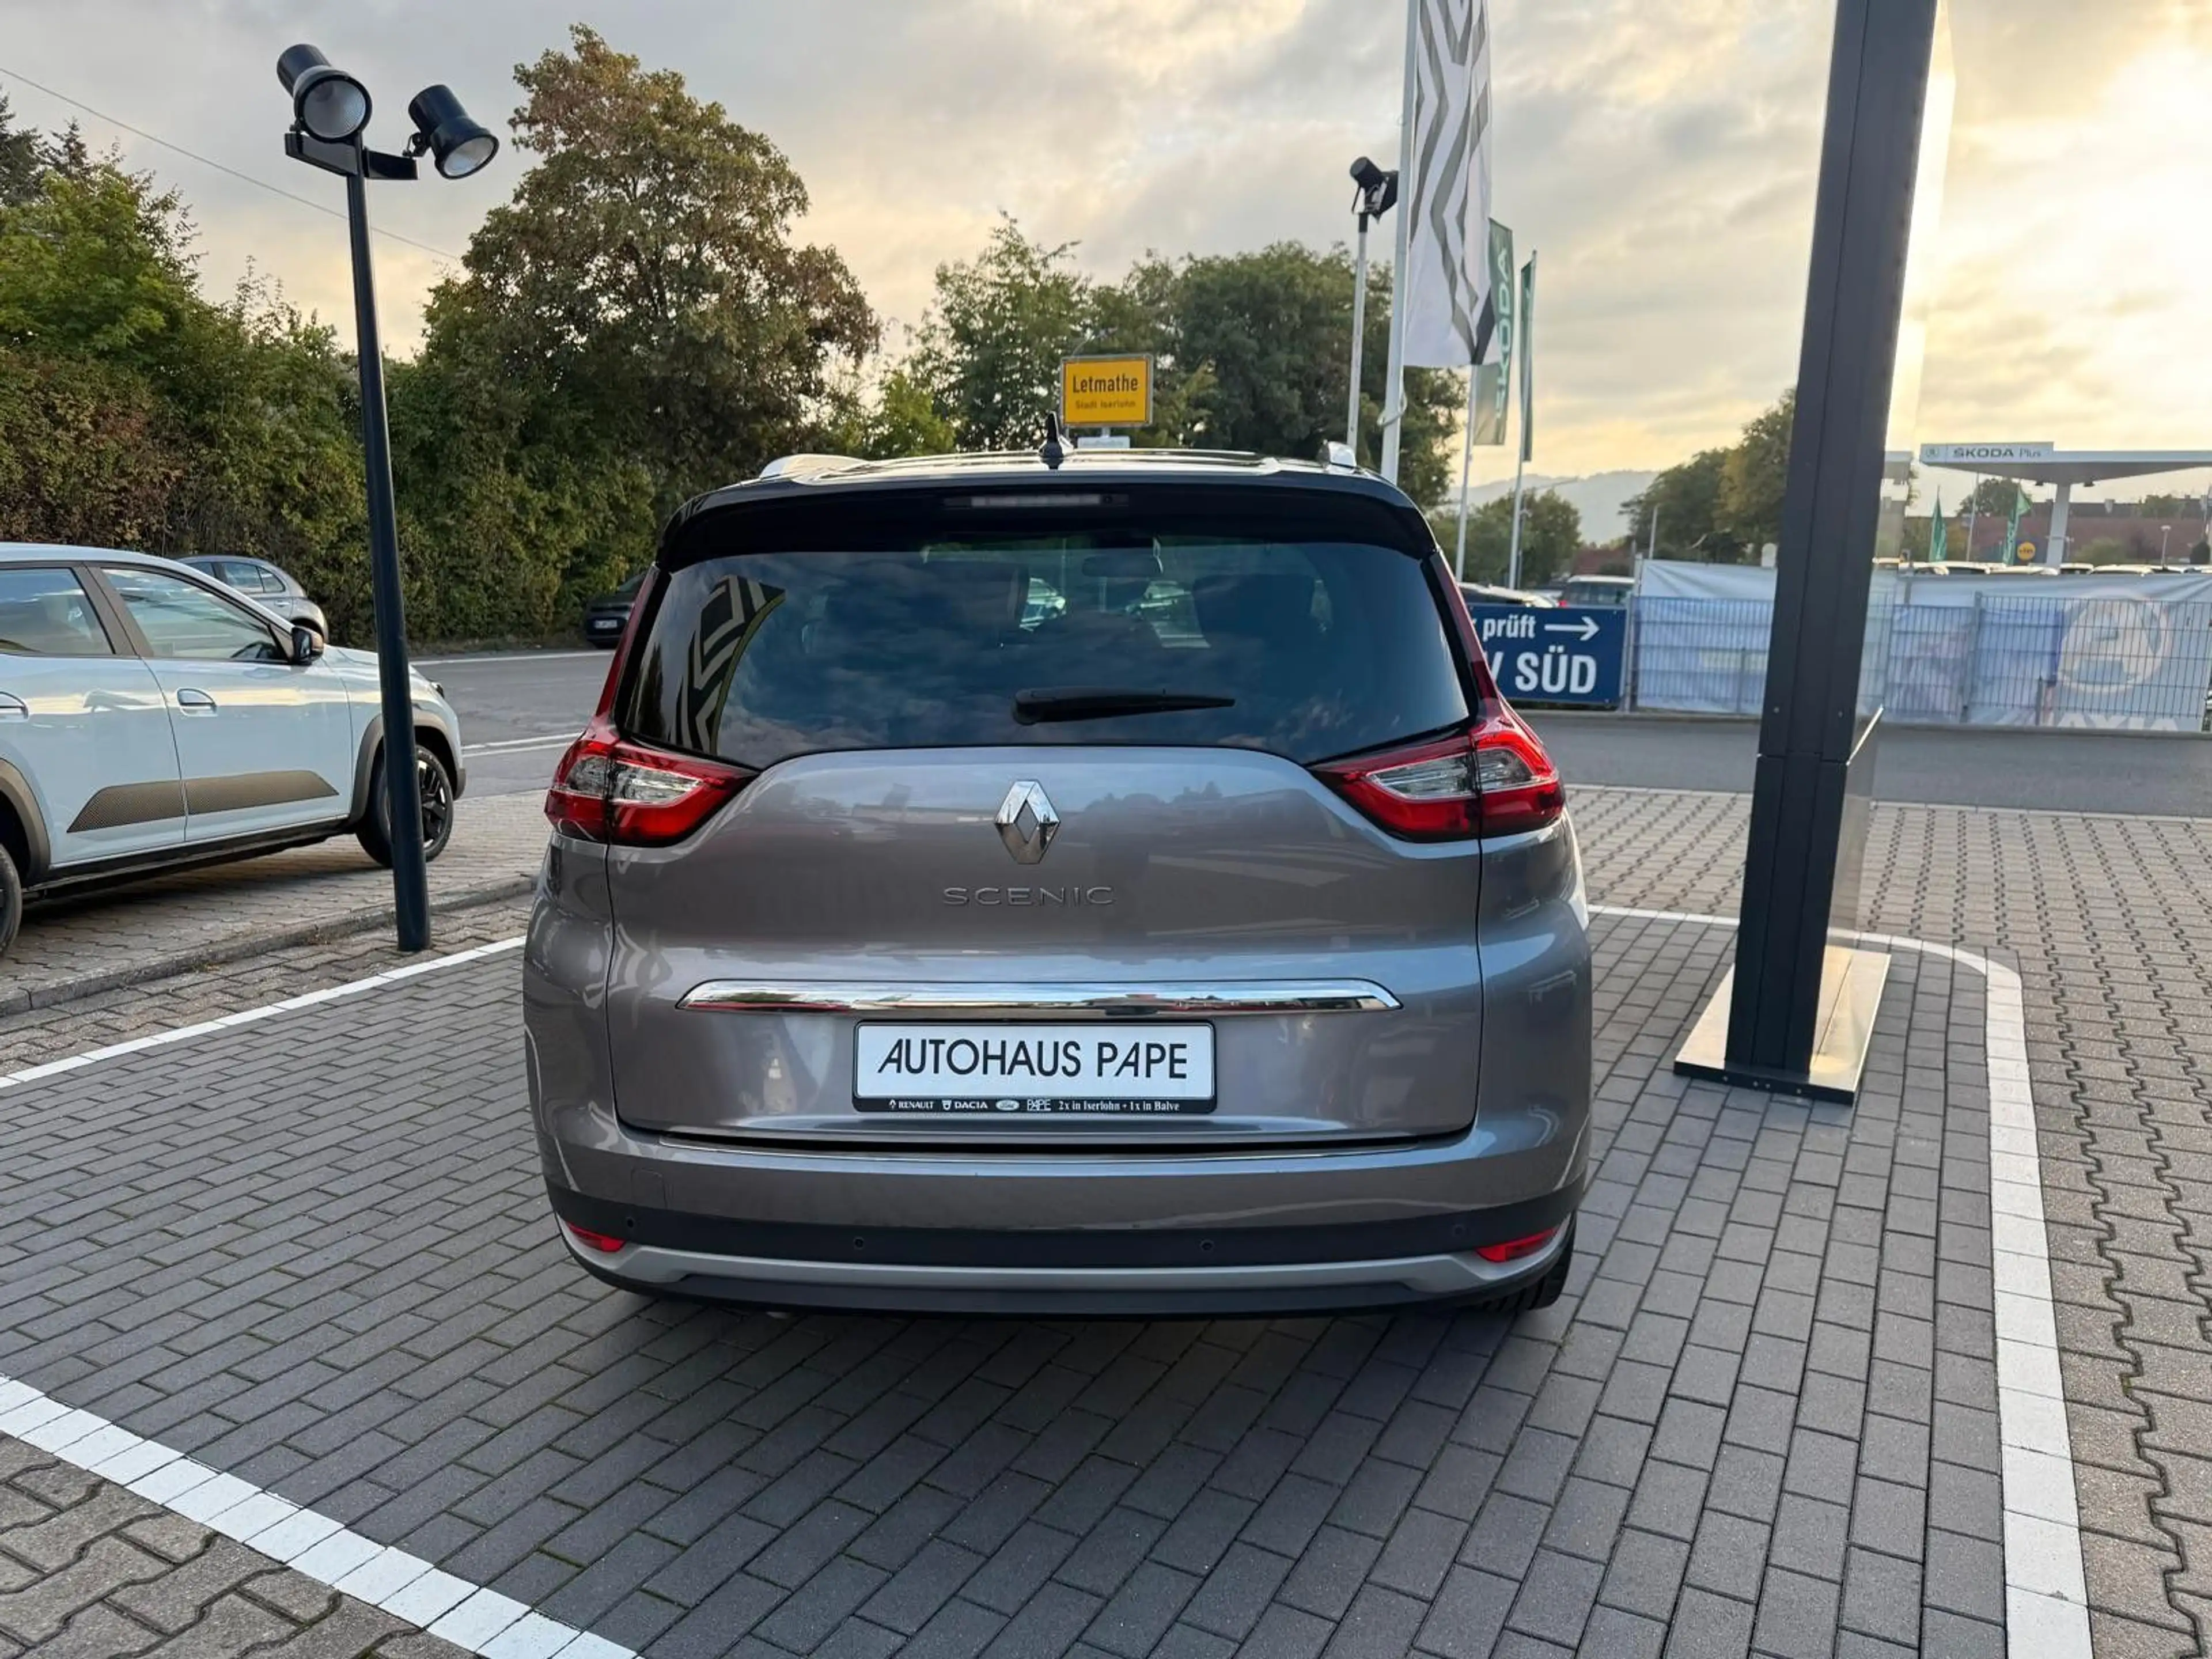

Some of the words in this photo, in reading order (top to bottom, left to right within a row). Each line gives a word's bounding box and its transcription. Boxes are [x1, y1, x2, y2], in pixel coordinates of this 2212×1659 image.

[1073, 374, 1138, 393] Letmathe
[1482, 614, 1536, 642] prüft
[1515, 645, 1597, 694] SÜD
[944, 886, 1114, 906] SCENIC
[878, 1038, 1081, 1077] AUTOHAUS
[1097, 1041, 1187, 1080] PAPE
[898, 1101, 934, 1110] RENAULT
[955, 1101, 988, 1109] DACIA
[1027, 1099, 1051, 1111] PAPE
[1058, 1101, 1069, 1110] 2x
[1073, 1101, 1081, 1110] in
[1084, 1101, 1120, 1111] Iserlohn
[1143, 1101, 1152, 1111] in
[1154, 1101, 1180, 1111] Balve
